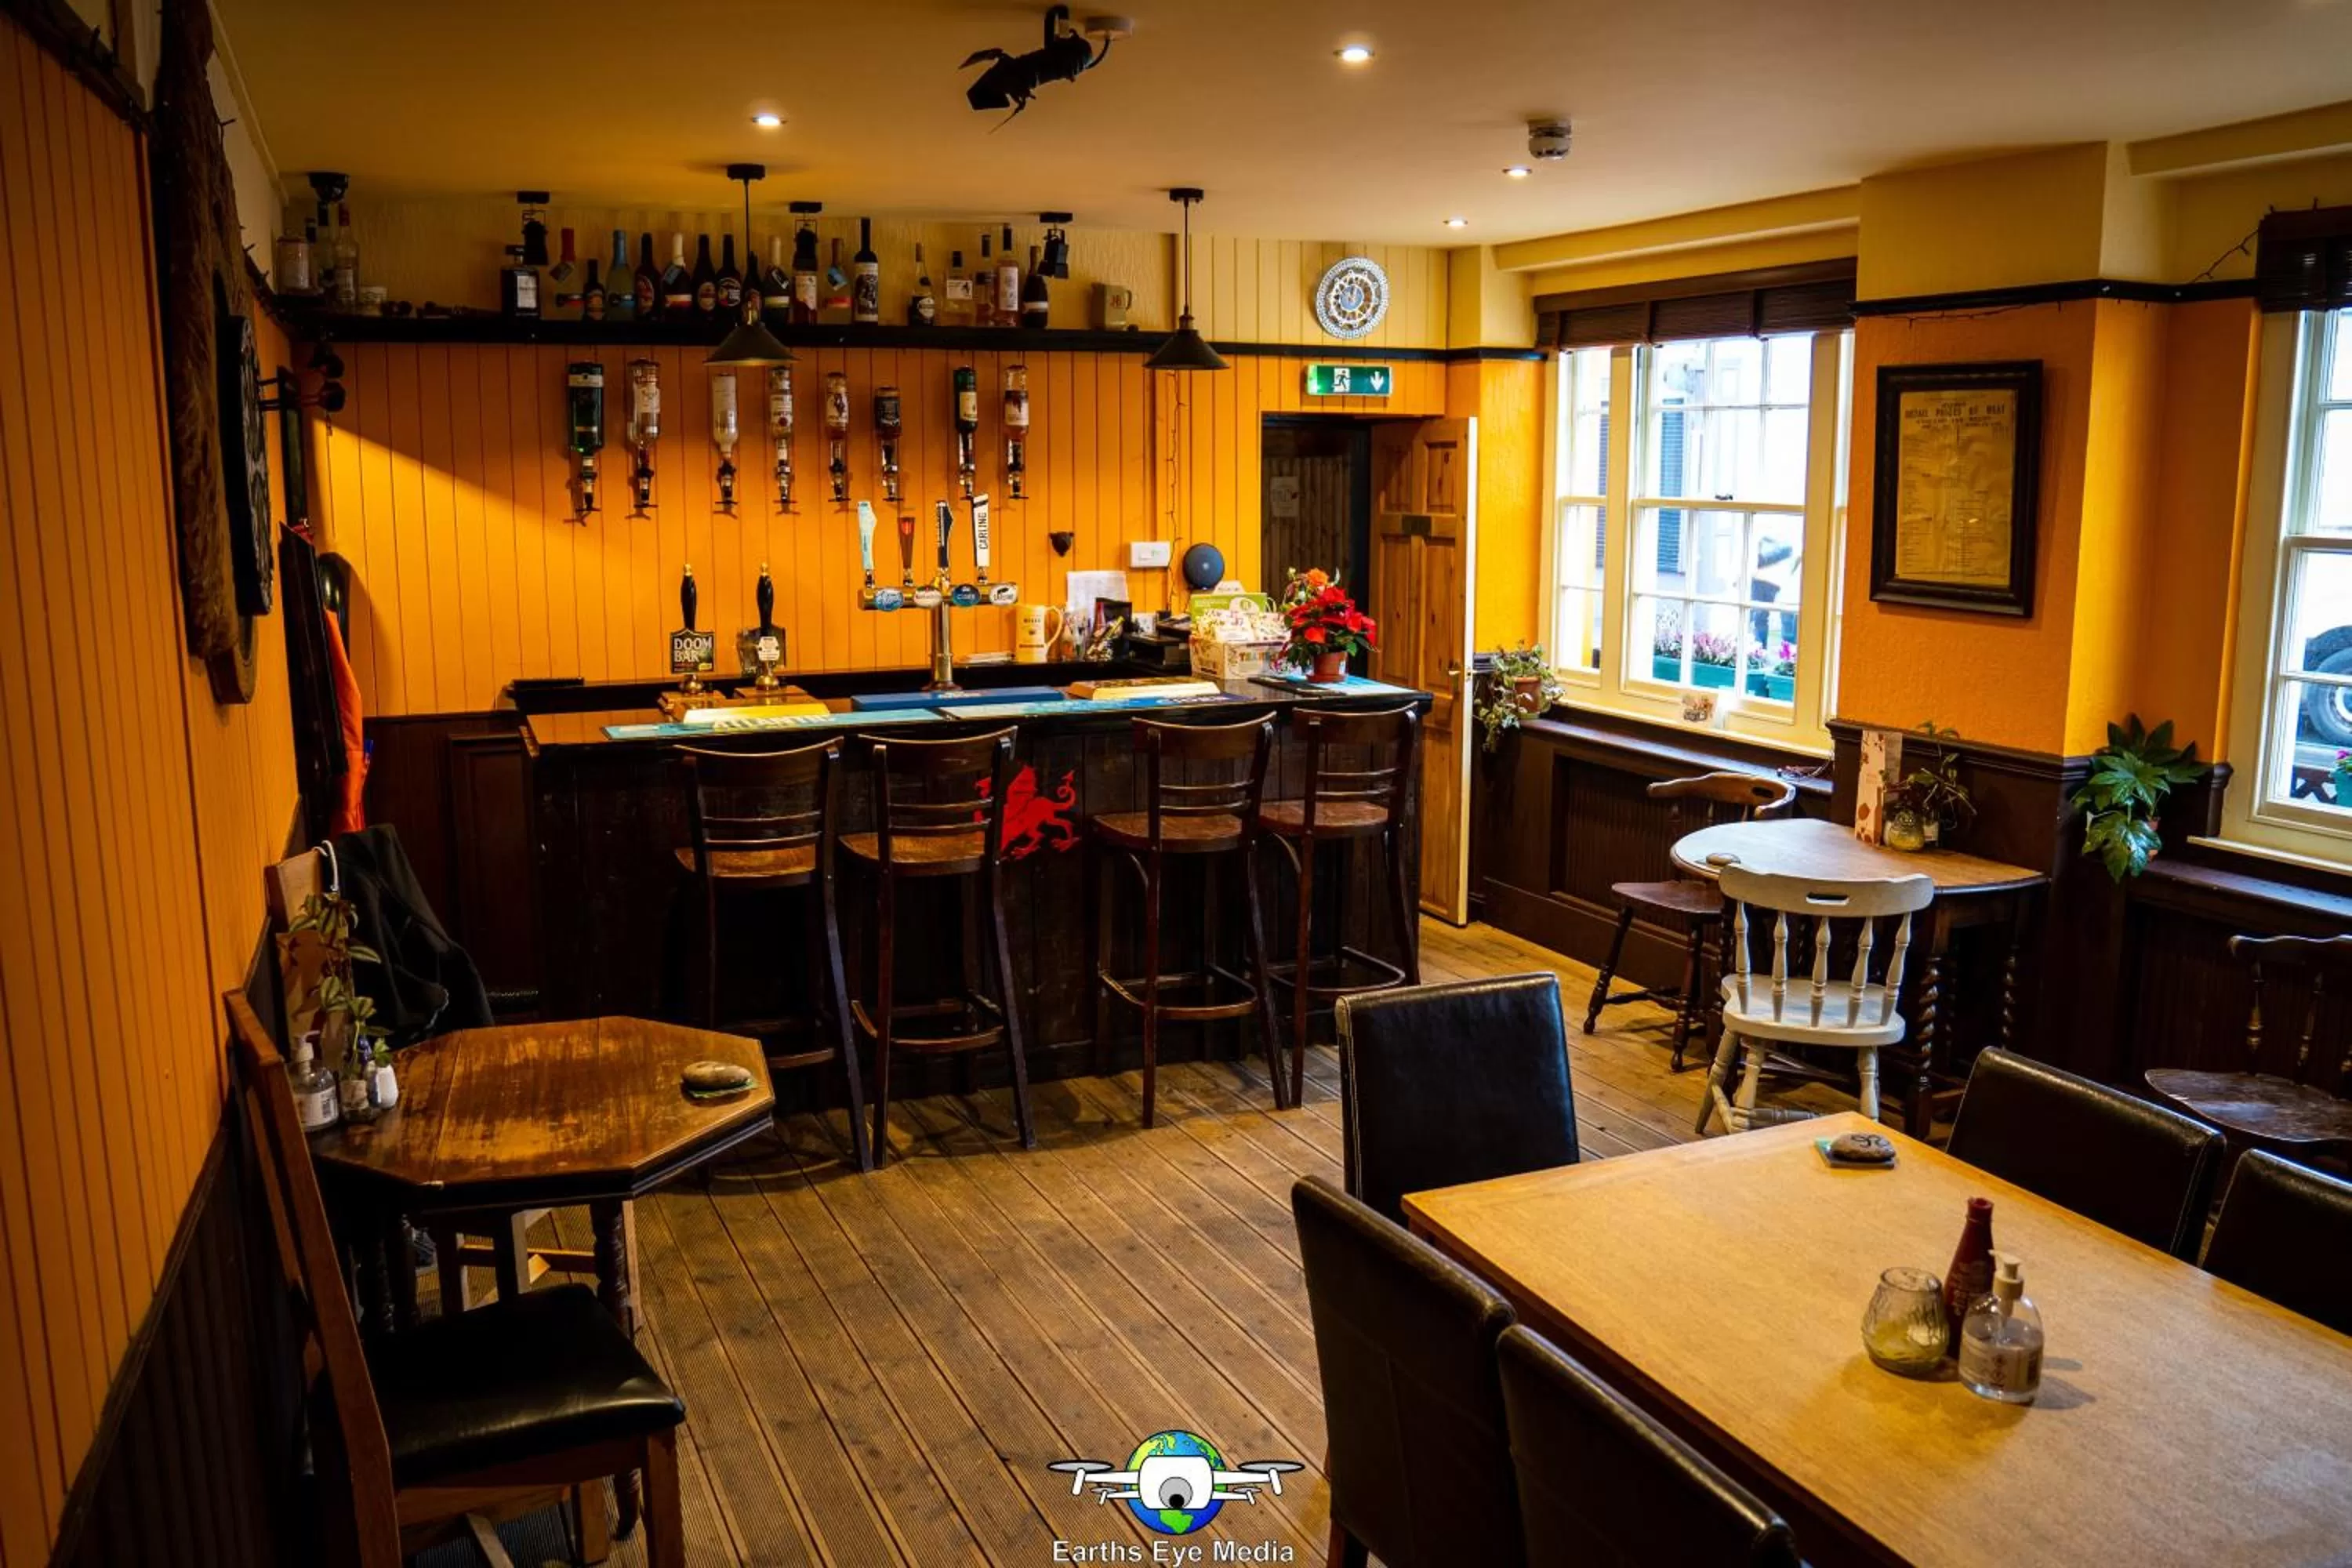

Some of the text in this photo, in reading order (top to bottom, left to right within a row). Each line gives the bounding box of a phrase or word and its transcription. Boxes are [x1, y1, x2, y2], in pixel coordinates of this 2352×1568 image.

[978, 512, 988, 550] CARLING
[673, 636, 712, 651] DOOM
[673, 650, 699, 662] BAR
